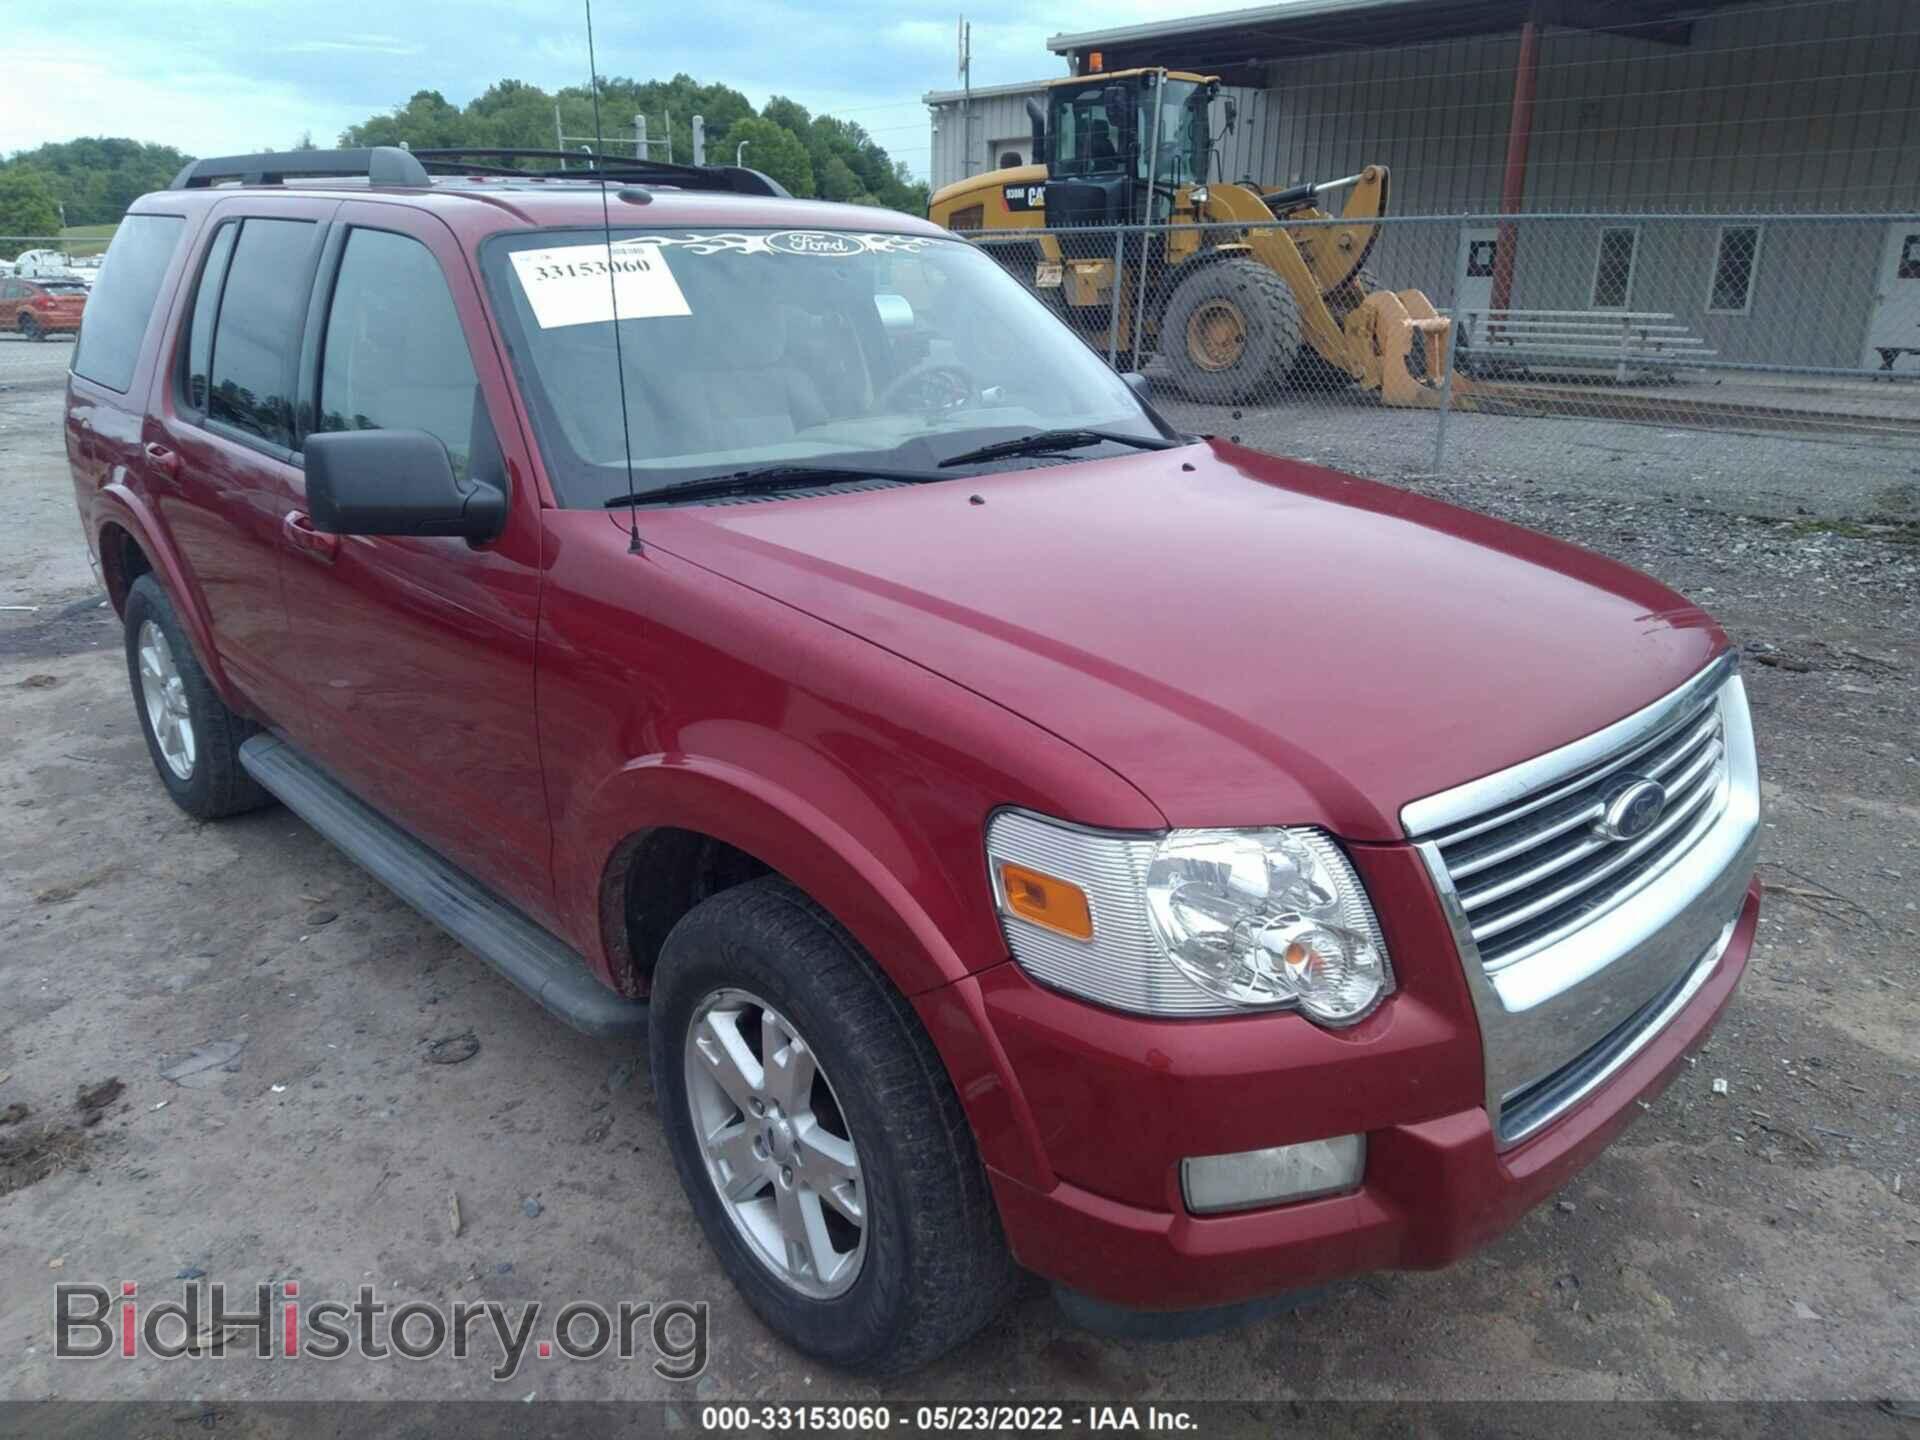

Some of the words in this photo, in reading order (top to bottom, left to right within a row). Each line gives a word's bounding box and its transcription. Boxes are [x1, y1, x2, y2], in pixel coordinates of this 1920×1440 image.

[1028, 186, 1046, 206] CA
[788, 233, 849, 252] Ford
[535, 258, 651, 281] 33153060
